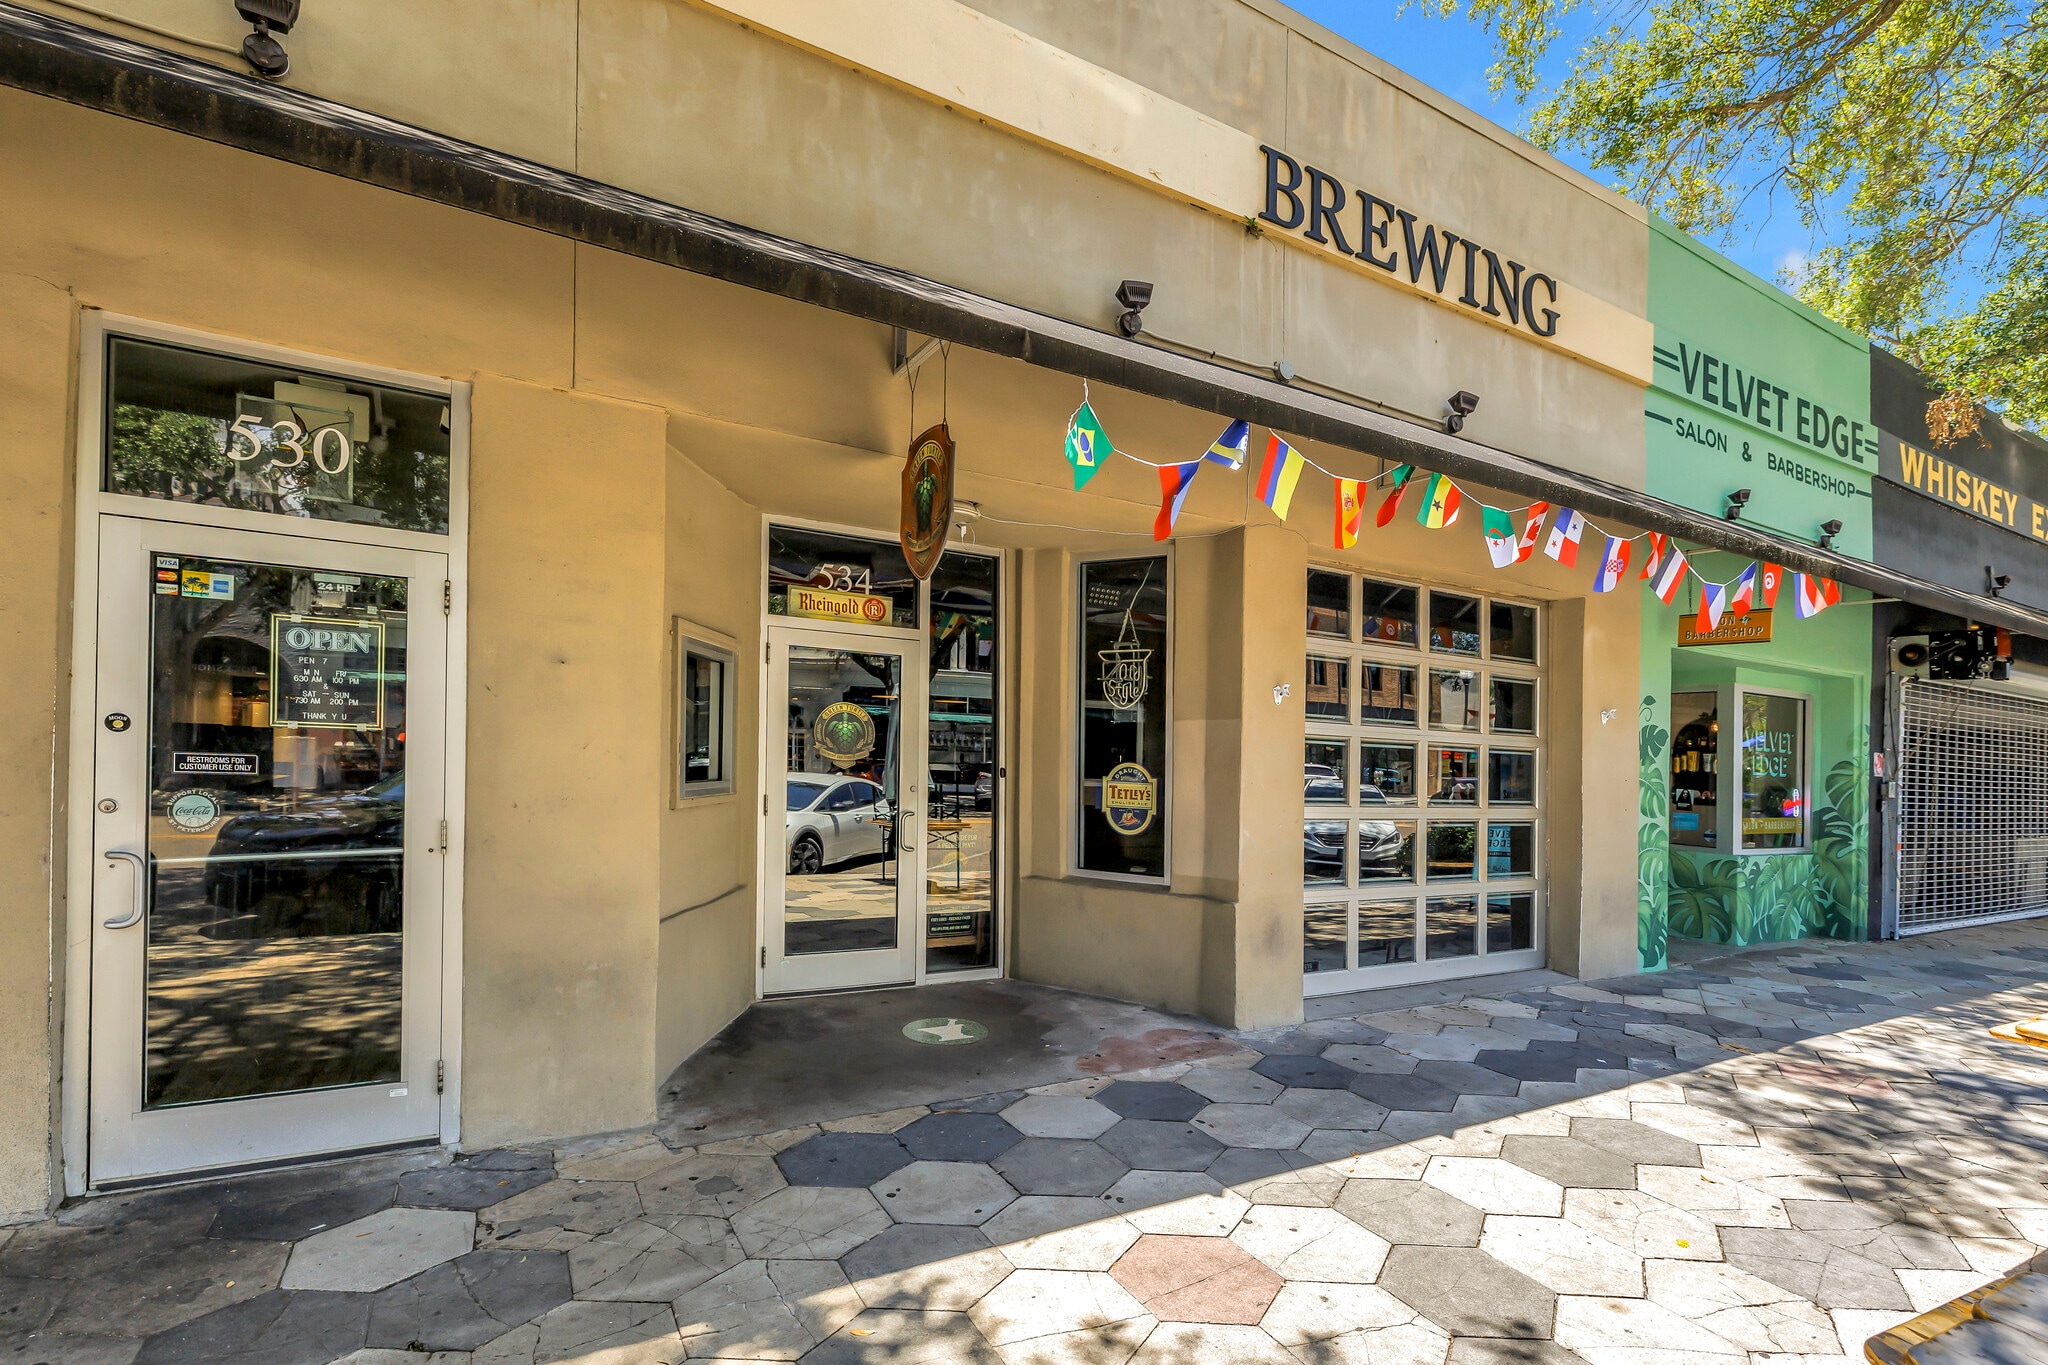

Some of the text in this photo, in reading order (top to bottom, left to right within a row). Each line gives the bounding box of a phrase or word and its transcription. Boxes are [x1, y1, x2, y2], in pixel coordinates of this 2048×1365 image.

[1258, 144, 1560, 337] BREWING
[1679, 342, 1864, 464] VELVET EDGE
[226, 414, 350, 474] 530
[910, 444, 943, 477] GREEN TURTLE
[1676, 417, 1856, 498] SALON & BARBERSHOP
[1899, 442, 2018, 527] WHISKEY
[159, 559, 178, 567] VISA
[318, 582, 333, 590] 24
[336, 584, 357, 592] HR.
[817, 563, 873, 595] 534
[798, 592, 859, 616] Rheingold
[285, 627, 372, 654] OPEN
[1685, 626, 1764, 640] BARBERSHOP
[293, 674, 309, 682] 630
[1119, 662, 1140, 681] Old
[295, 696, 308, 704] 730
[310, 697, 320, 705] AM
[334, 691, 350, 699] SUN
[1108, 679, 1139, 705] Style
[302, 712, 327, 720] THANK
[825, 704, 866, 720] GREEN TURTLE
[1745, 726, 1795, 755] VELVET
[179, 763, 253, 772] CUSTOMER USE ONLY
[187, 756, 230, 764] RESTROOMS
[1752, 754, 1788, 778] EDGE
[1115, 767, 1147, 781] DRAUGHT
[167, 789, 219, 806] SUPPORT LOCAL
[1109, 784, 1151, 801] TETLEY'S
[180, 816, 220, 833] PETERSBURG
[1743, 821, 1758, 830] SALON
